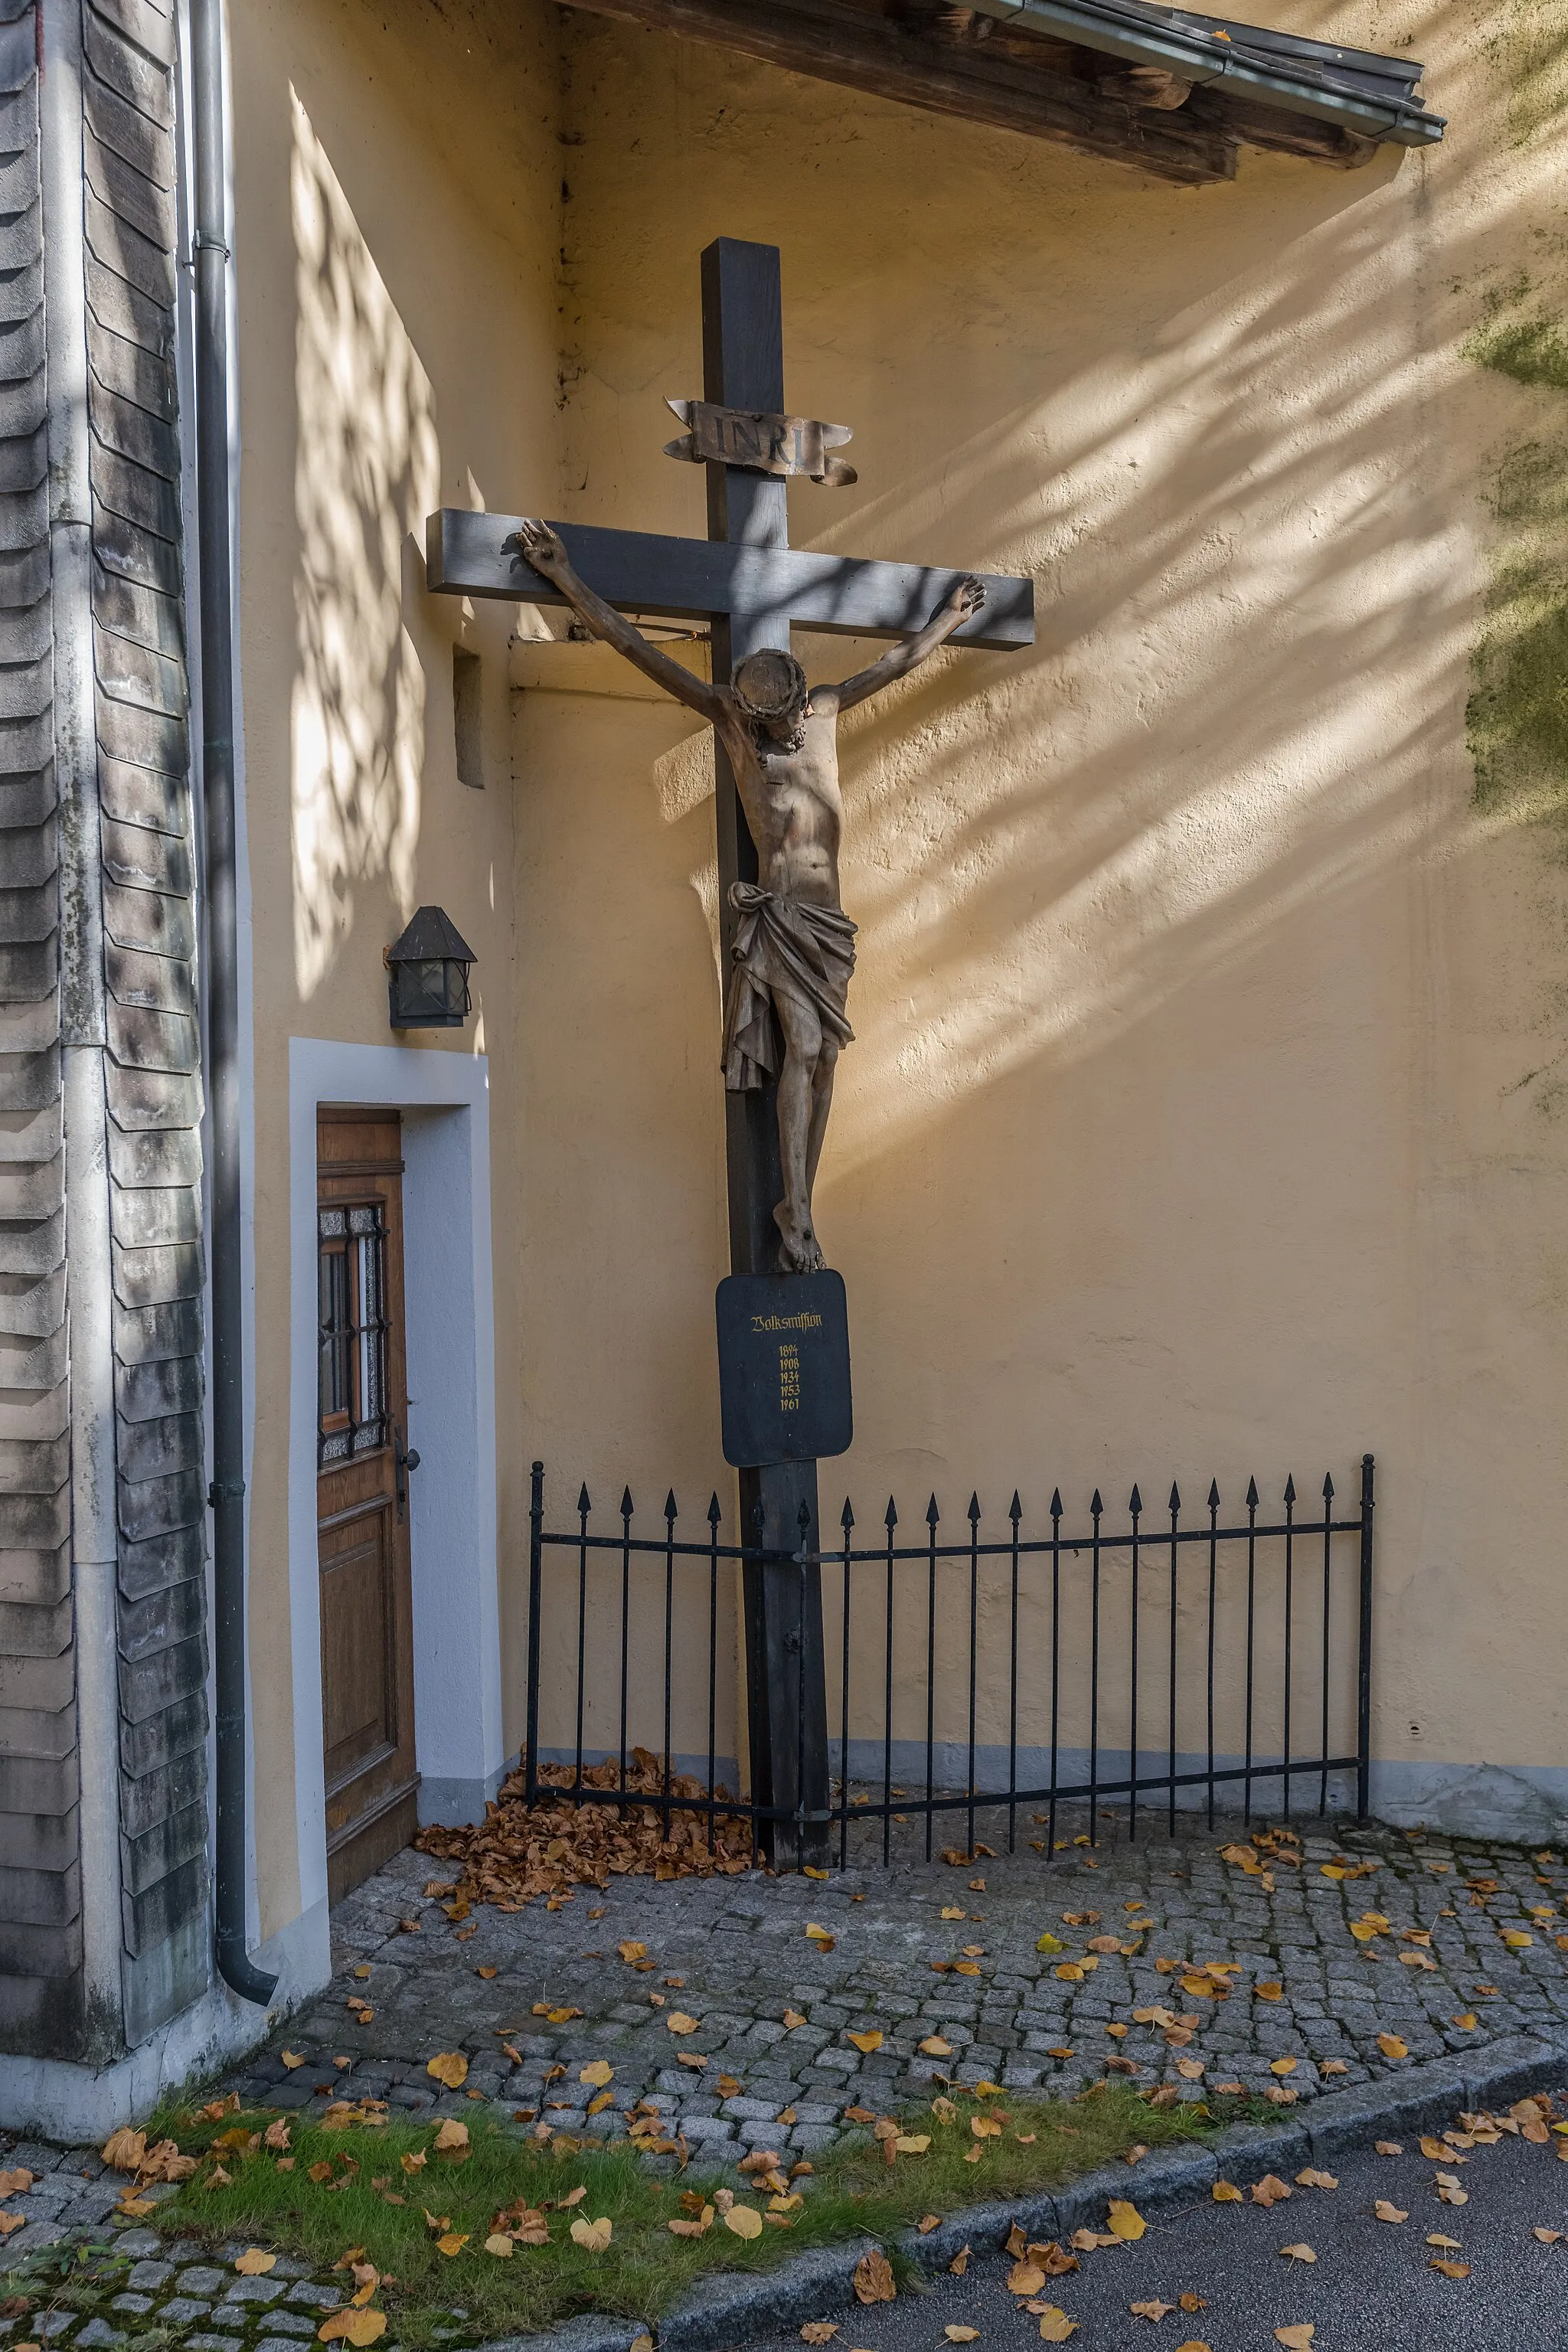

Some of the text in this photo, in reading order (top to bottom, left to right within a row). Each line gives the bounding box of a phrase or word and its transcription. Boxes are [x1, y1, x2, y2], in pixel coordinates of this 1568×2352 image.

[714, 416, 805, 466] INRI
[779, 1344, 799, 1357] 1894
[779, 1358, 799, 1370] 1908
[780, 1371, 799, 1383] 1934
[780, 1384, 800, 1396] 1953
[780, 1398, 799, 1411] 1961
